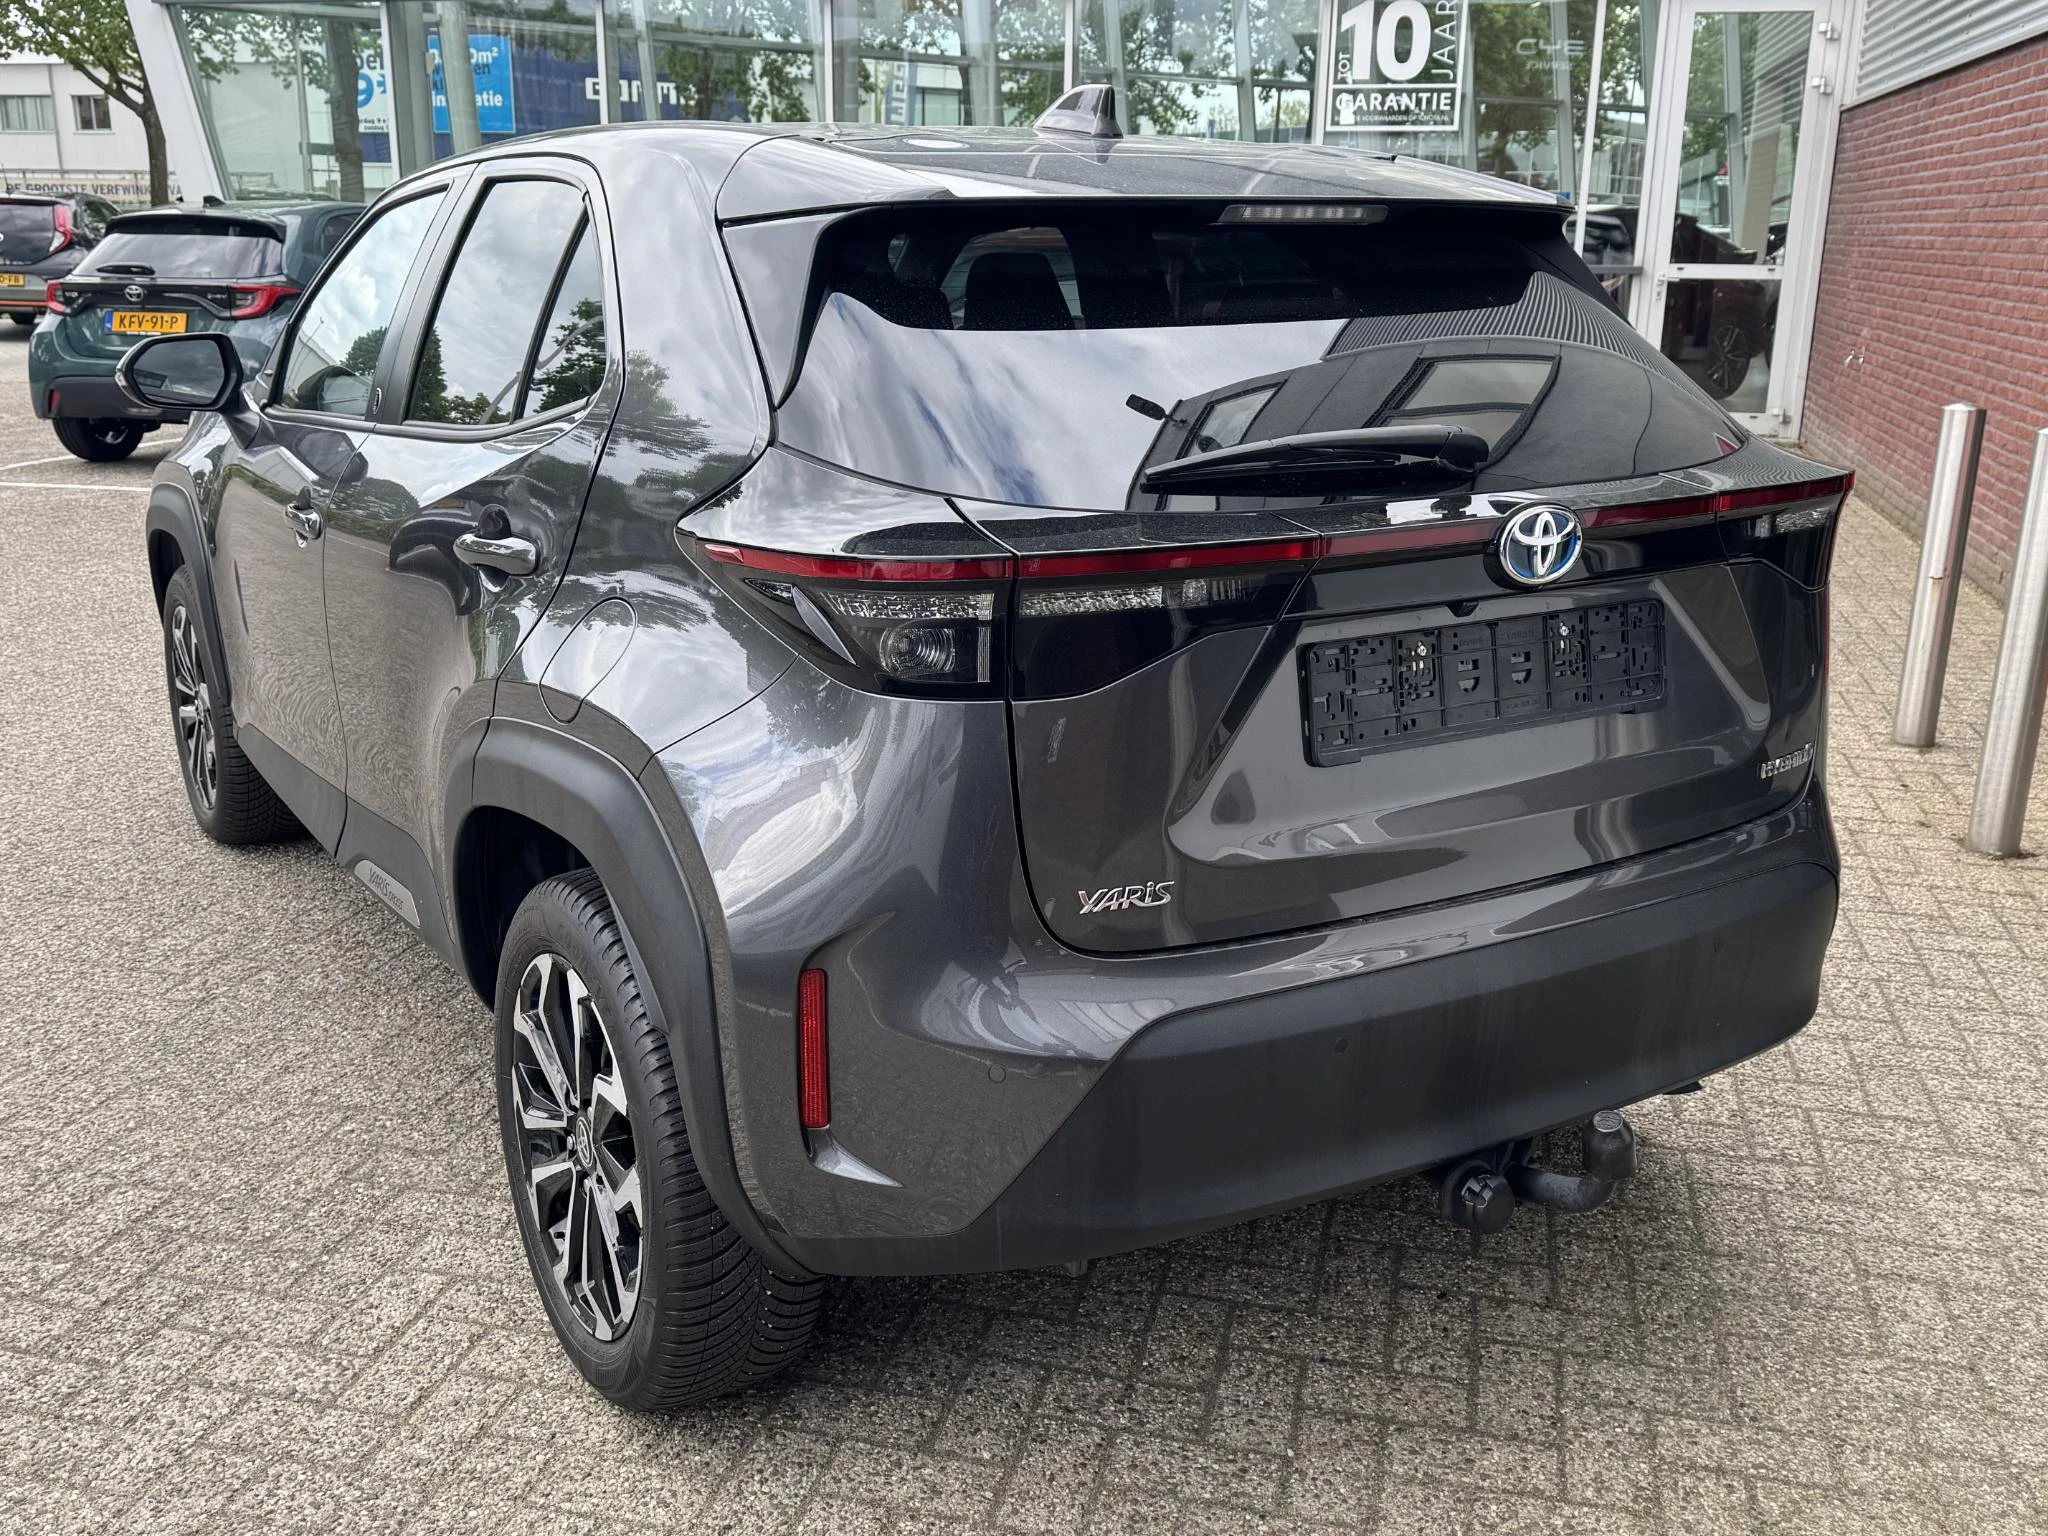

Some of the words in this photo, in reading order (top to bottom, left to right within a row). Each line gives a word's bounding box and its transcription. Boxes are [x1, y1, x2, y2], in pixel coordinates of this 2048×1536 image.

[1340, 0, 1431, 80] 10
[1431, 0, 1457, 80] JAAR
[1335, 92, 1451, 112] GARANTIE
[92, 184, 165, 195] VERFWINK
[119, 314, 178, 329] KFV-91-P
